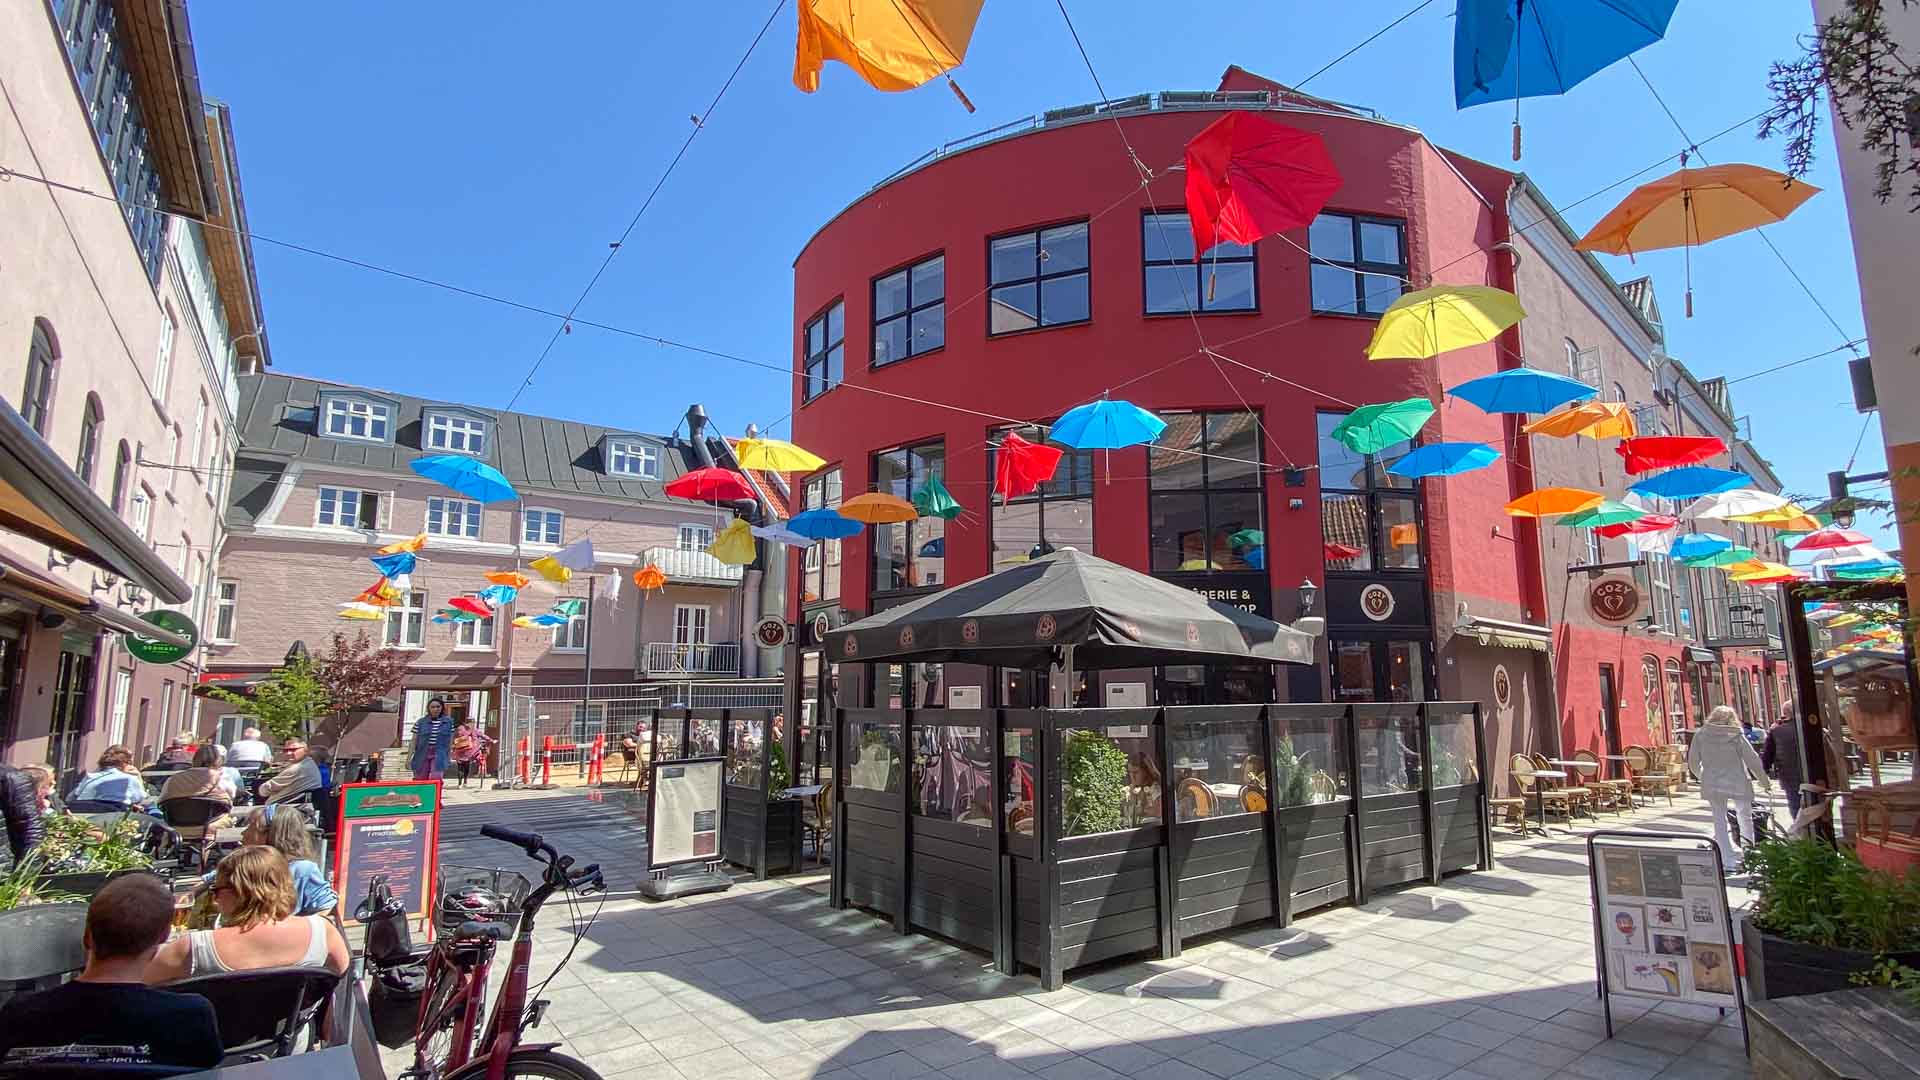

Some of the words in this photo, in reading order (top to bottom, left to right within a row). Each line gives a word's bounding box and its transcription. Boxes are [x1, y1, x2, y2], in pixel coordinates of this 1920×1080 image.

[1596, 584, 1632, 596] COZY
[1241, 590, 1250, 600] &
[1368, 591, 1386, 599] COZY
[762, 623, 781, 631] COZY
